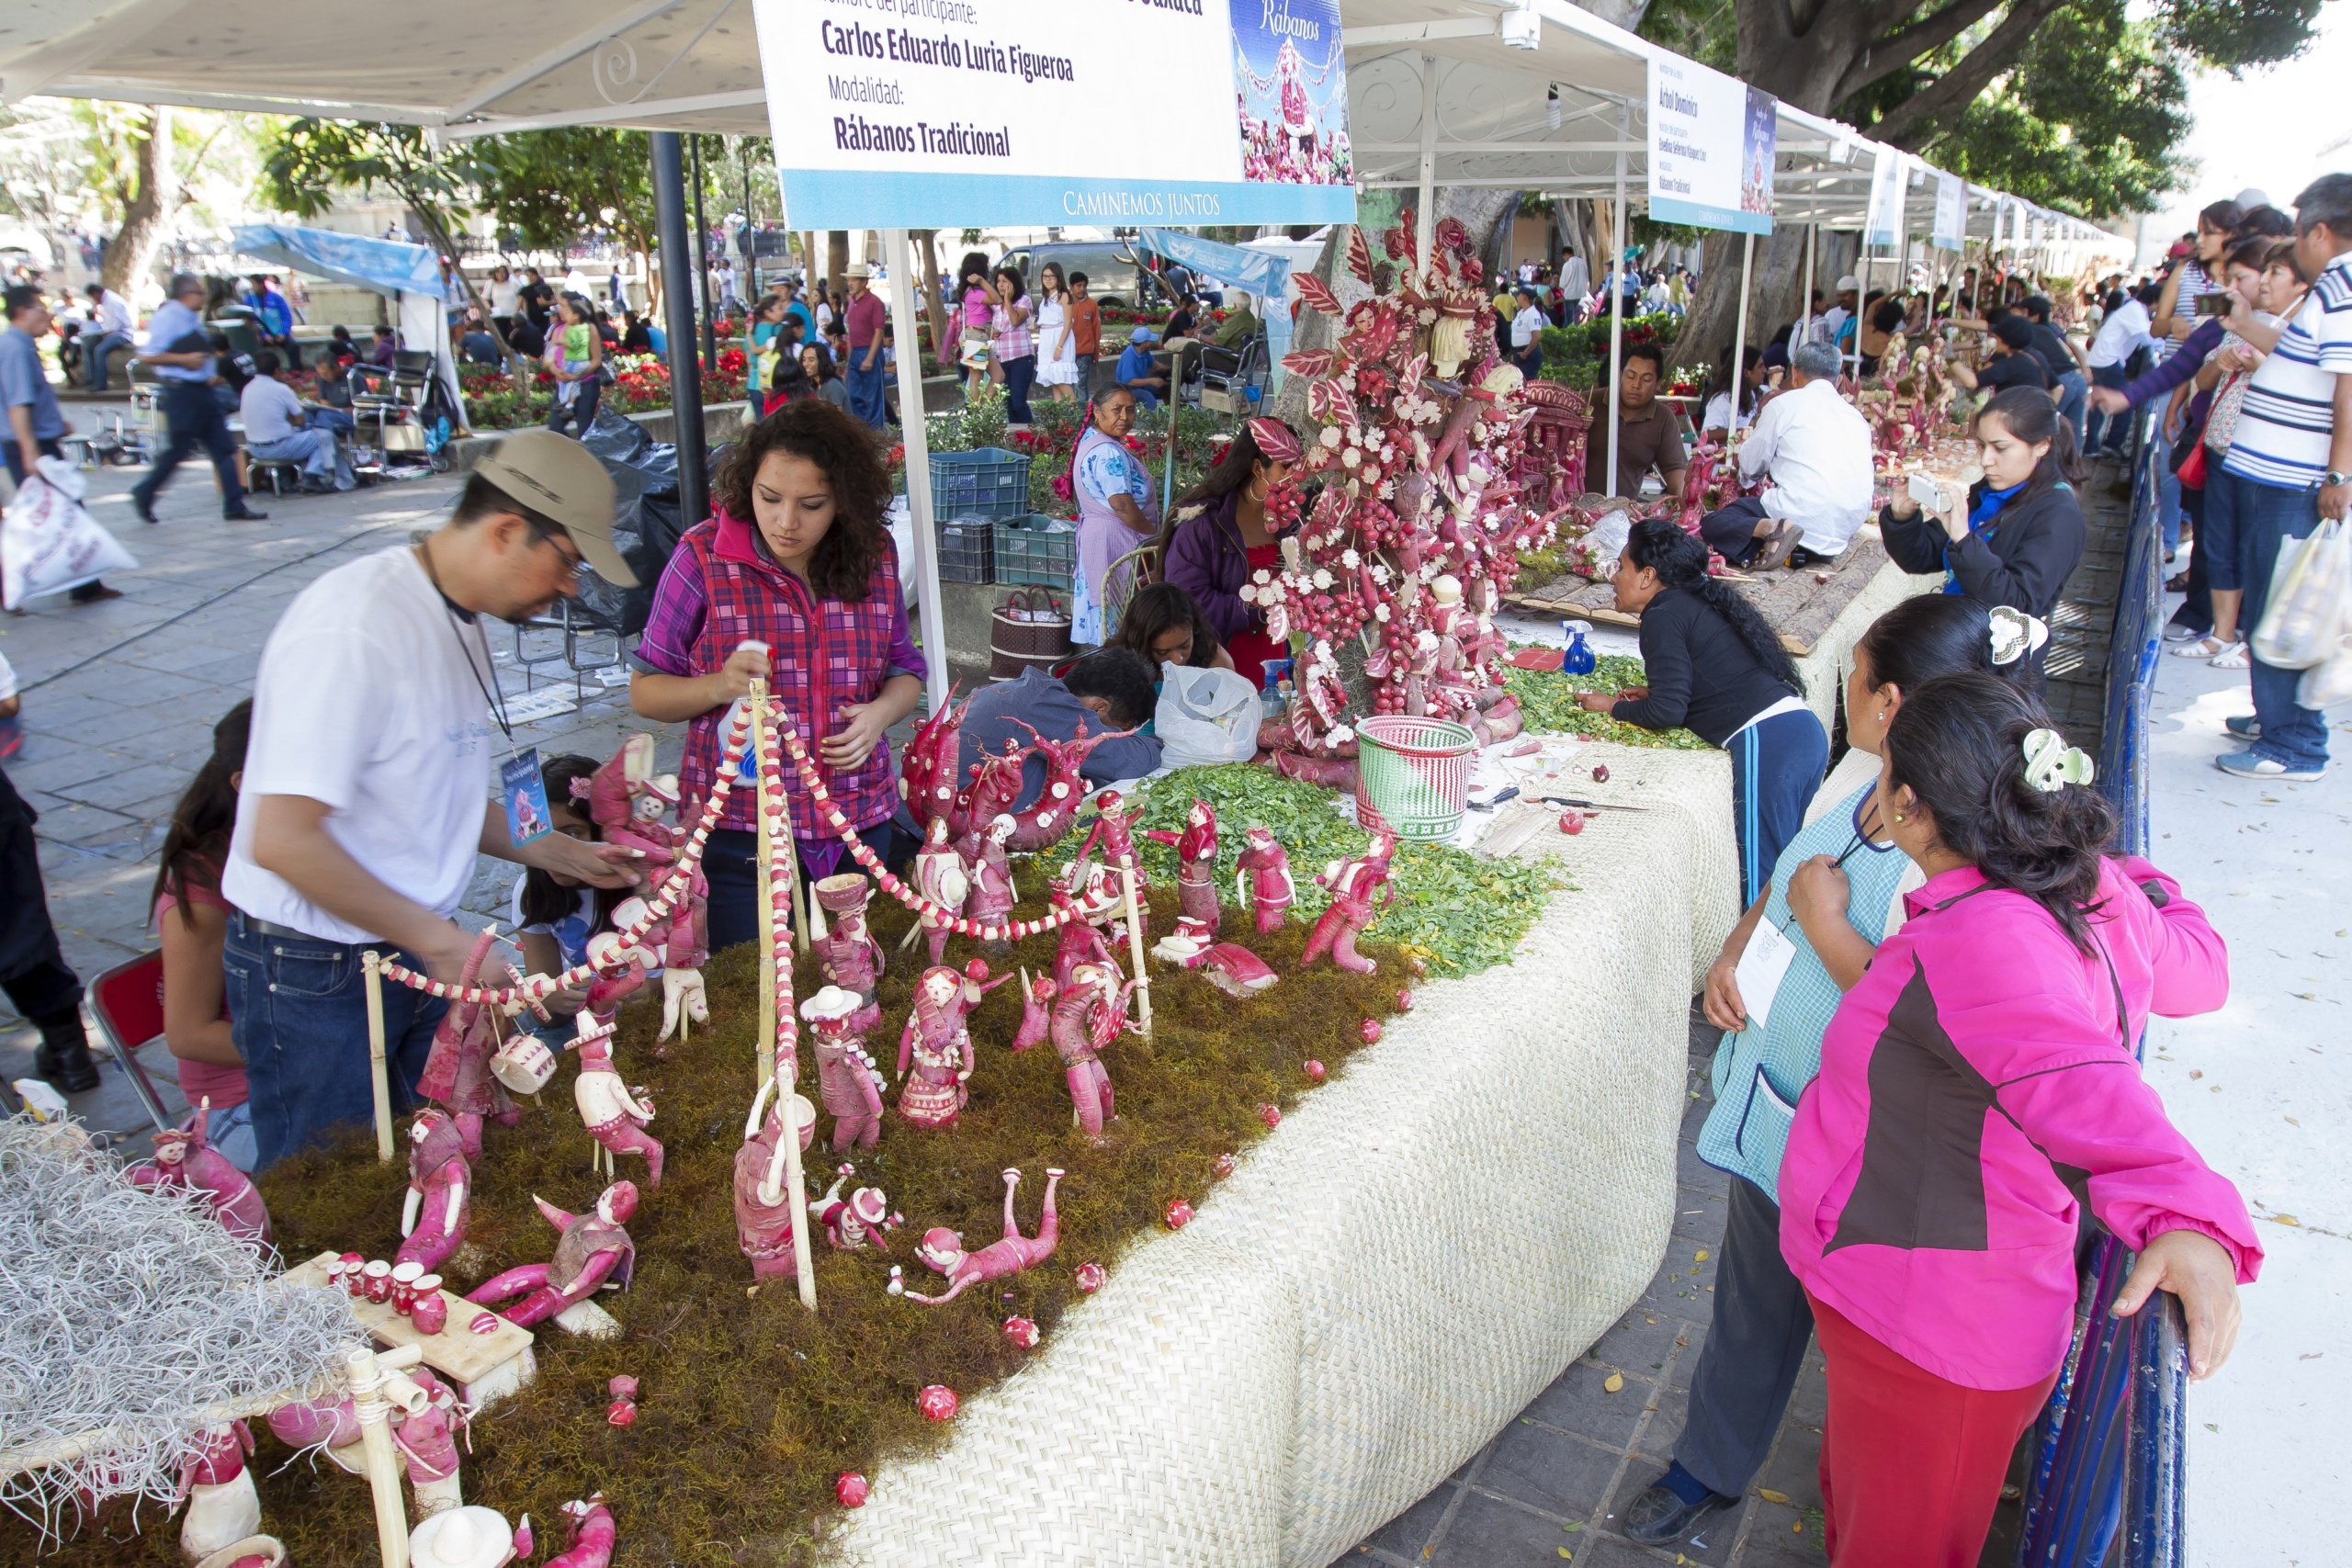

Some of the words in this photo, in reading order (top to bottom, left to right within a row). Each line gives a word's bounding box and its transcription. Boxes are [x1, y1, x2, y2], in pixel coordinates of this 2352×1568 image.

[1260, 0, 1319, 41] Rábanos
[821, 19, 885, 60] Carlos
[887, 28, 962, 68] Eduardo
[965, 39, 1008, 73] Luria
[1009, 44, 1074, 84] Figueroa
[828, 74, 904, 106] Modalidad:
[1659, 80, 1674, 110] Árbol
[833, 113, 916, 152] Rábanos
[918, 121, 1011, 157] Tradicional
[1063, 190, 1163, 216] CAMINEMOS
[1168, 193, 1220, 221] JUNTOS
